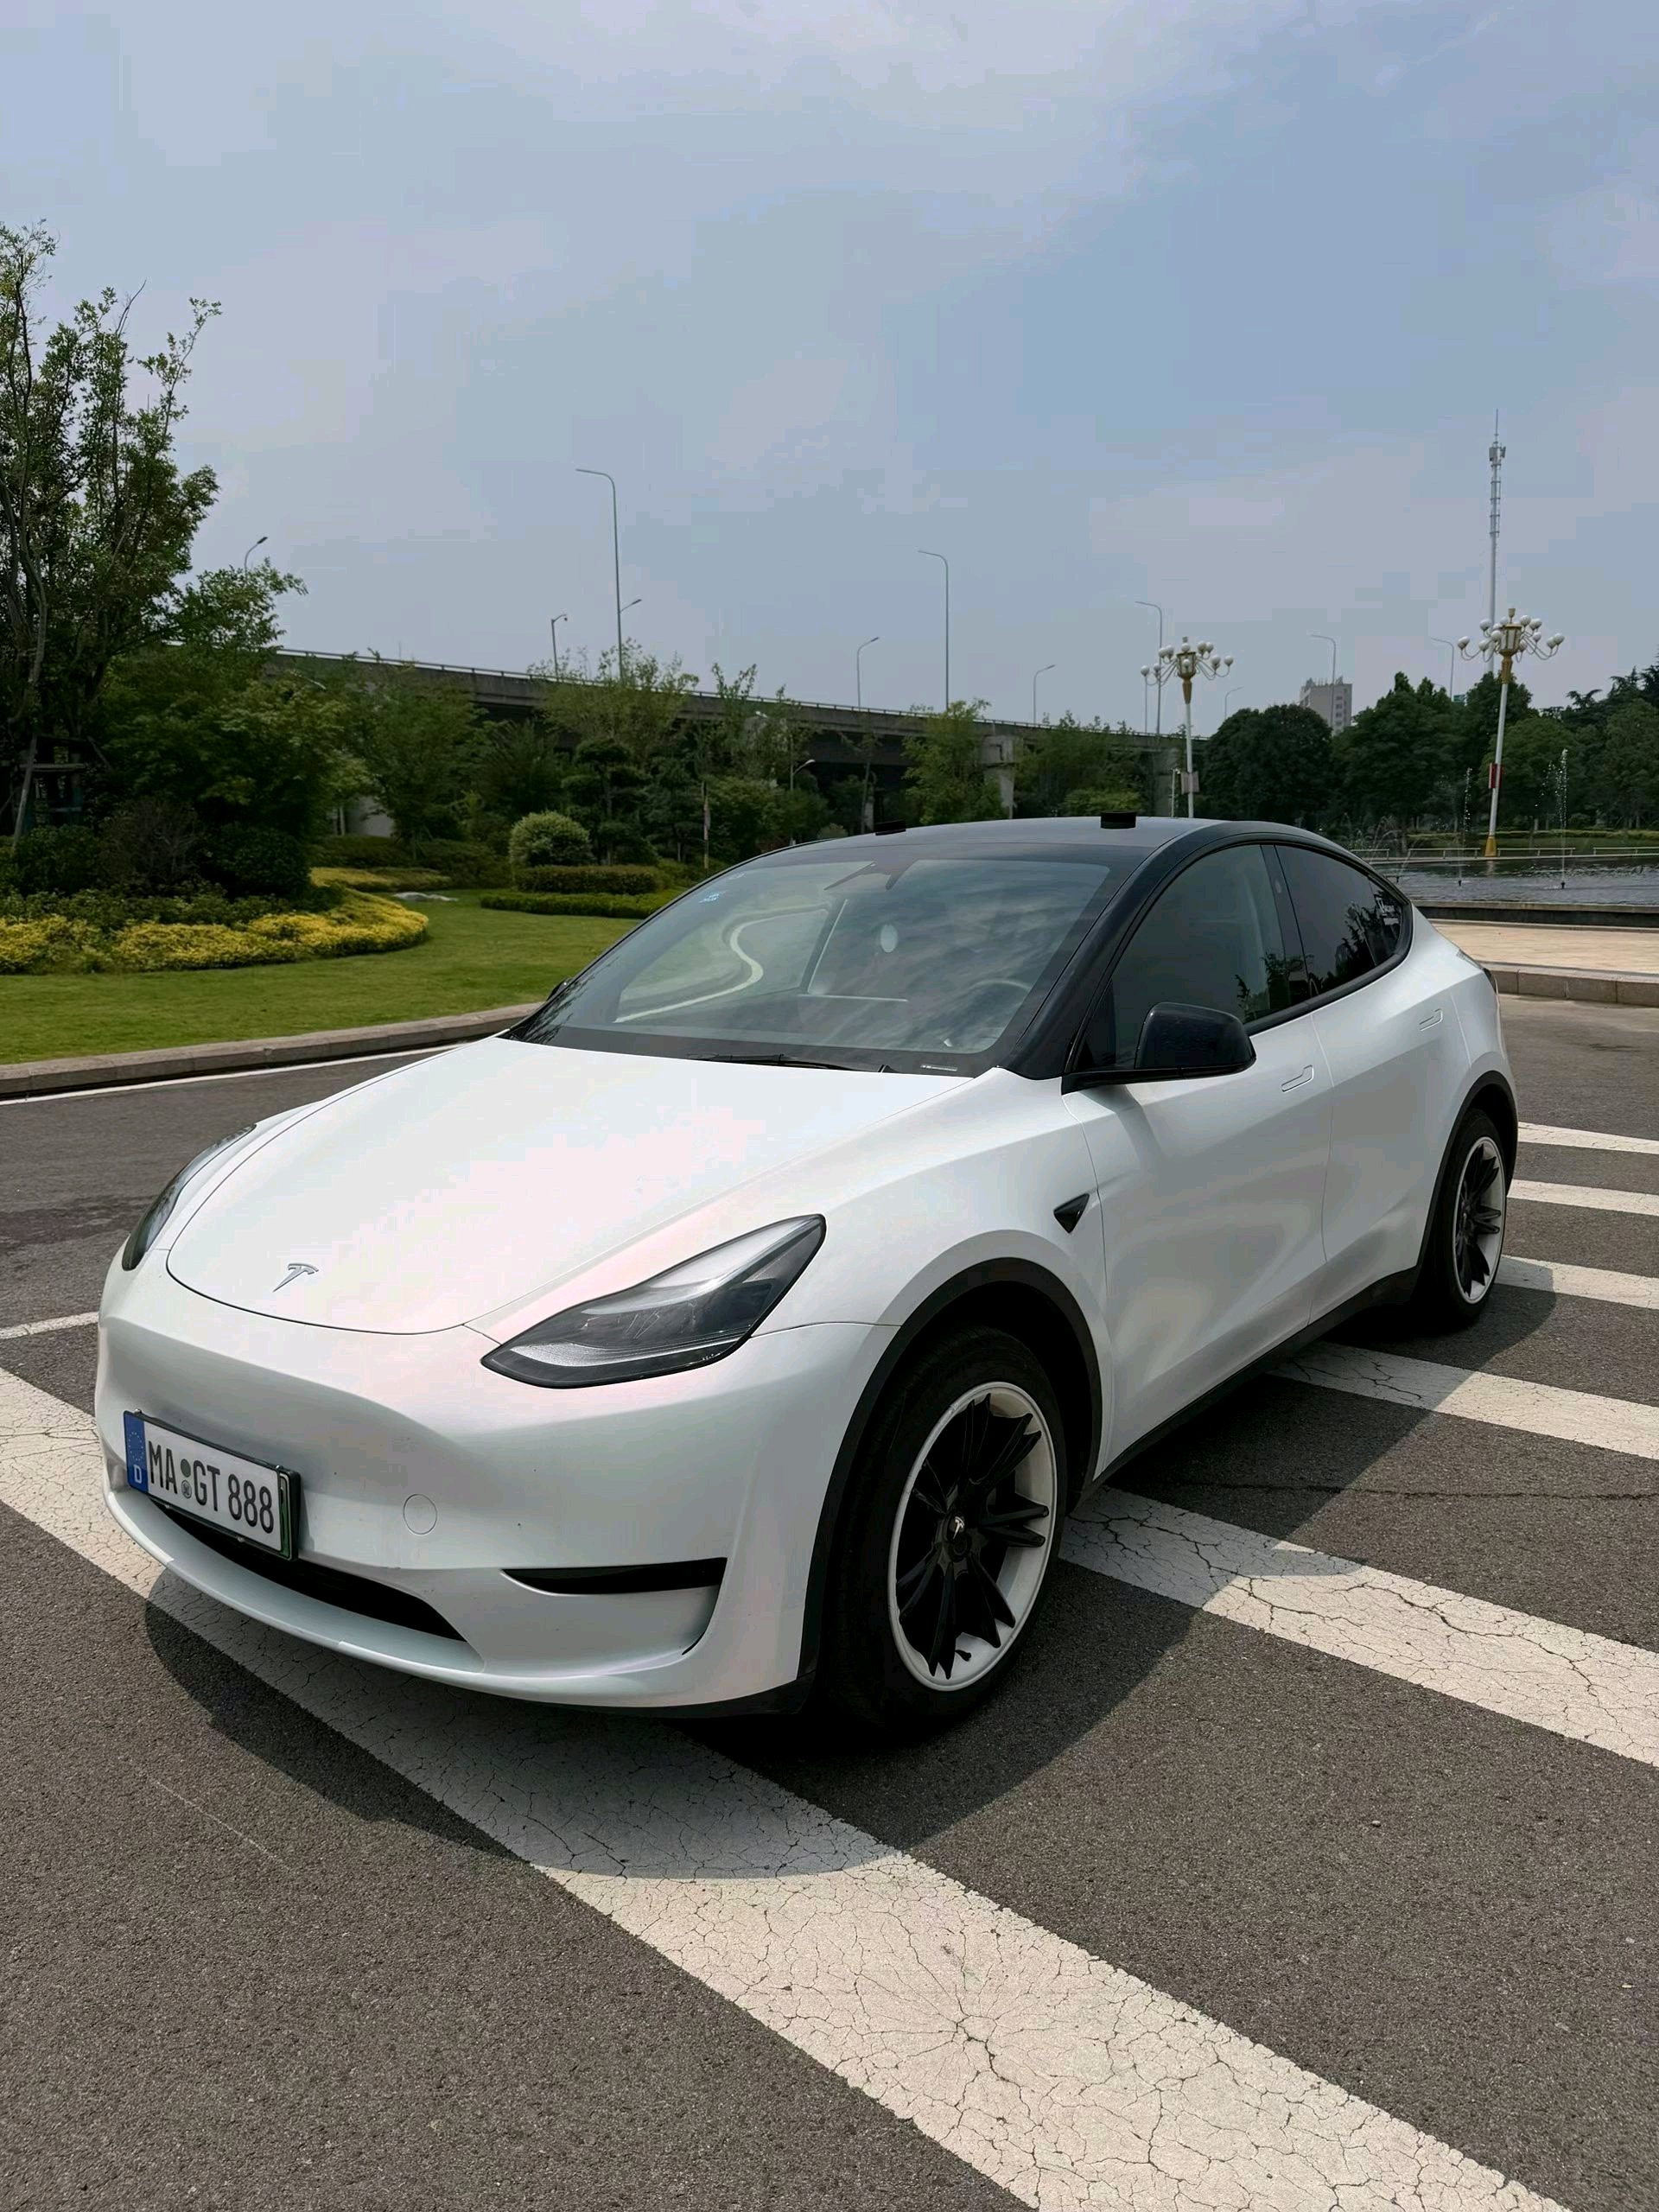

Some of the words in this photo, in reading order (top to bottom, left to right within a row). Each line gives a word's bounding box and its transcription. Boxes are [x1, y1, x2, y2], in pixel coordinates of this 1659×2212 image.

[133, 1464, 143, 1484] D
[148, 1440, 178, 1495] MA
[193, 1459, 220, 1512] GT
[227, 1473, 274, 1534] 888
